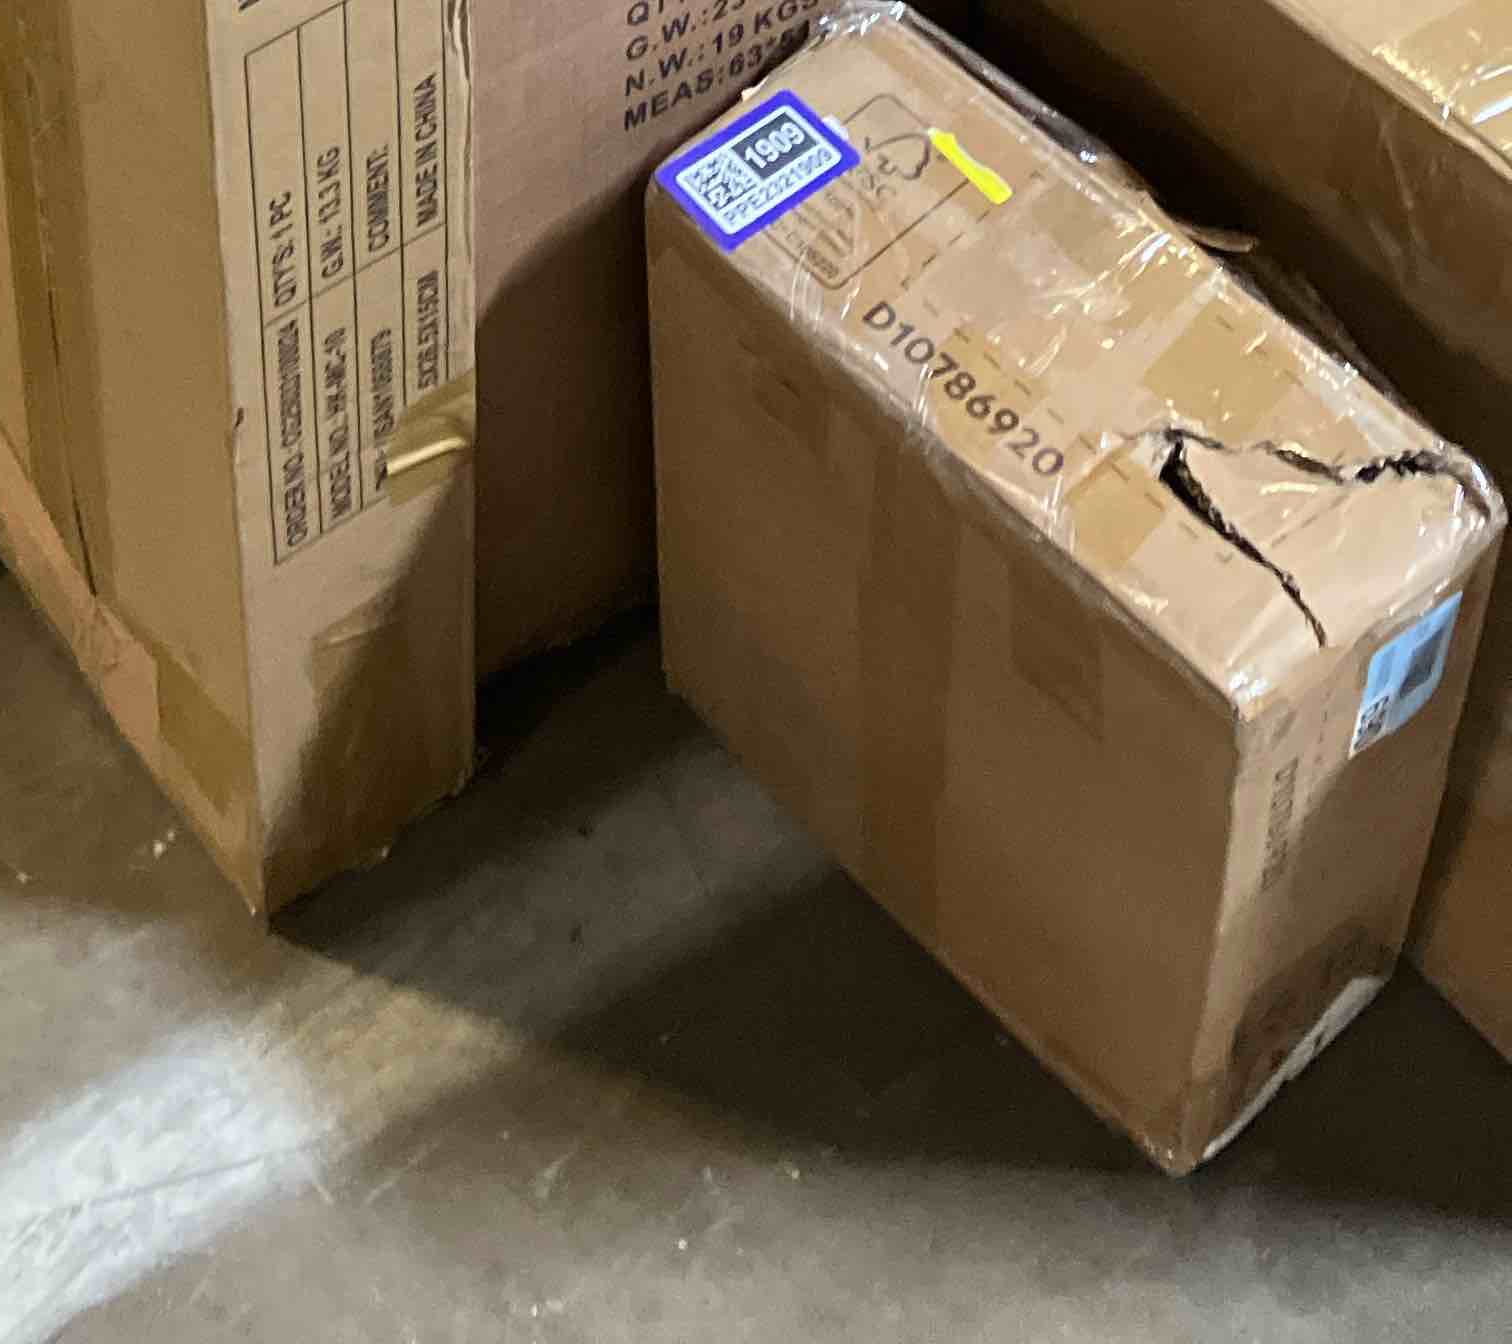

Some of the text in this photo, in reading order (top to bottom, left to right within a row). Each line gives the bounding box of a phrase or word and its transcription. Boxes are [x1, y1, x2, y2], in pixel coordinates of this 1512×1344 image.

[413, 72, 438, 142] CHINA
[744, 121, 806, 170] 1909
[415, 163, 439, 228] MADE
[861, 300, 1065, 477] D10786920
